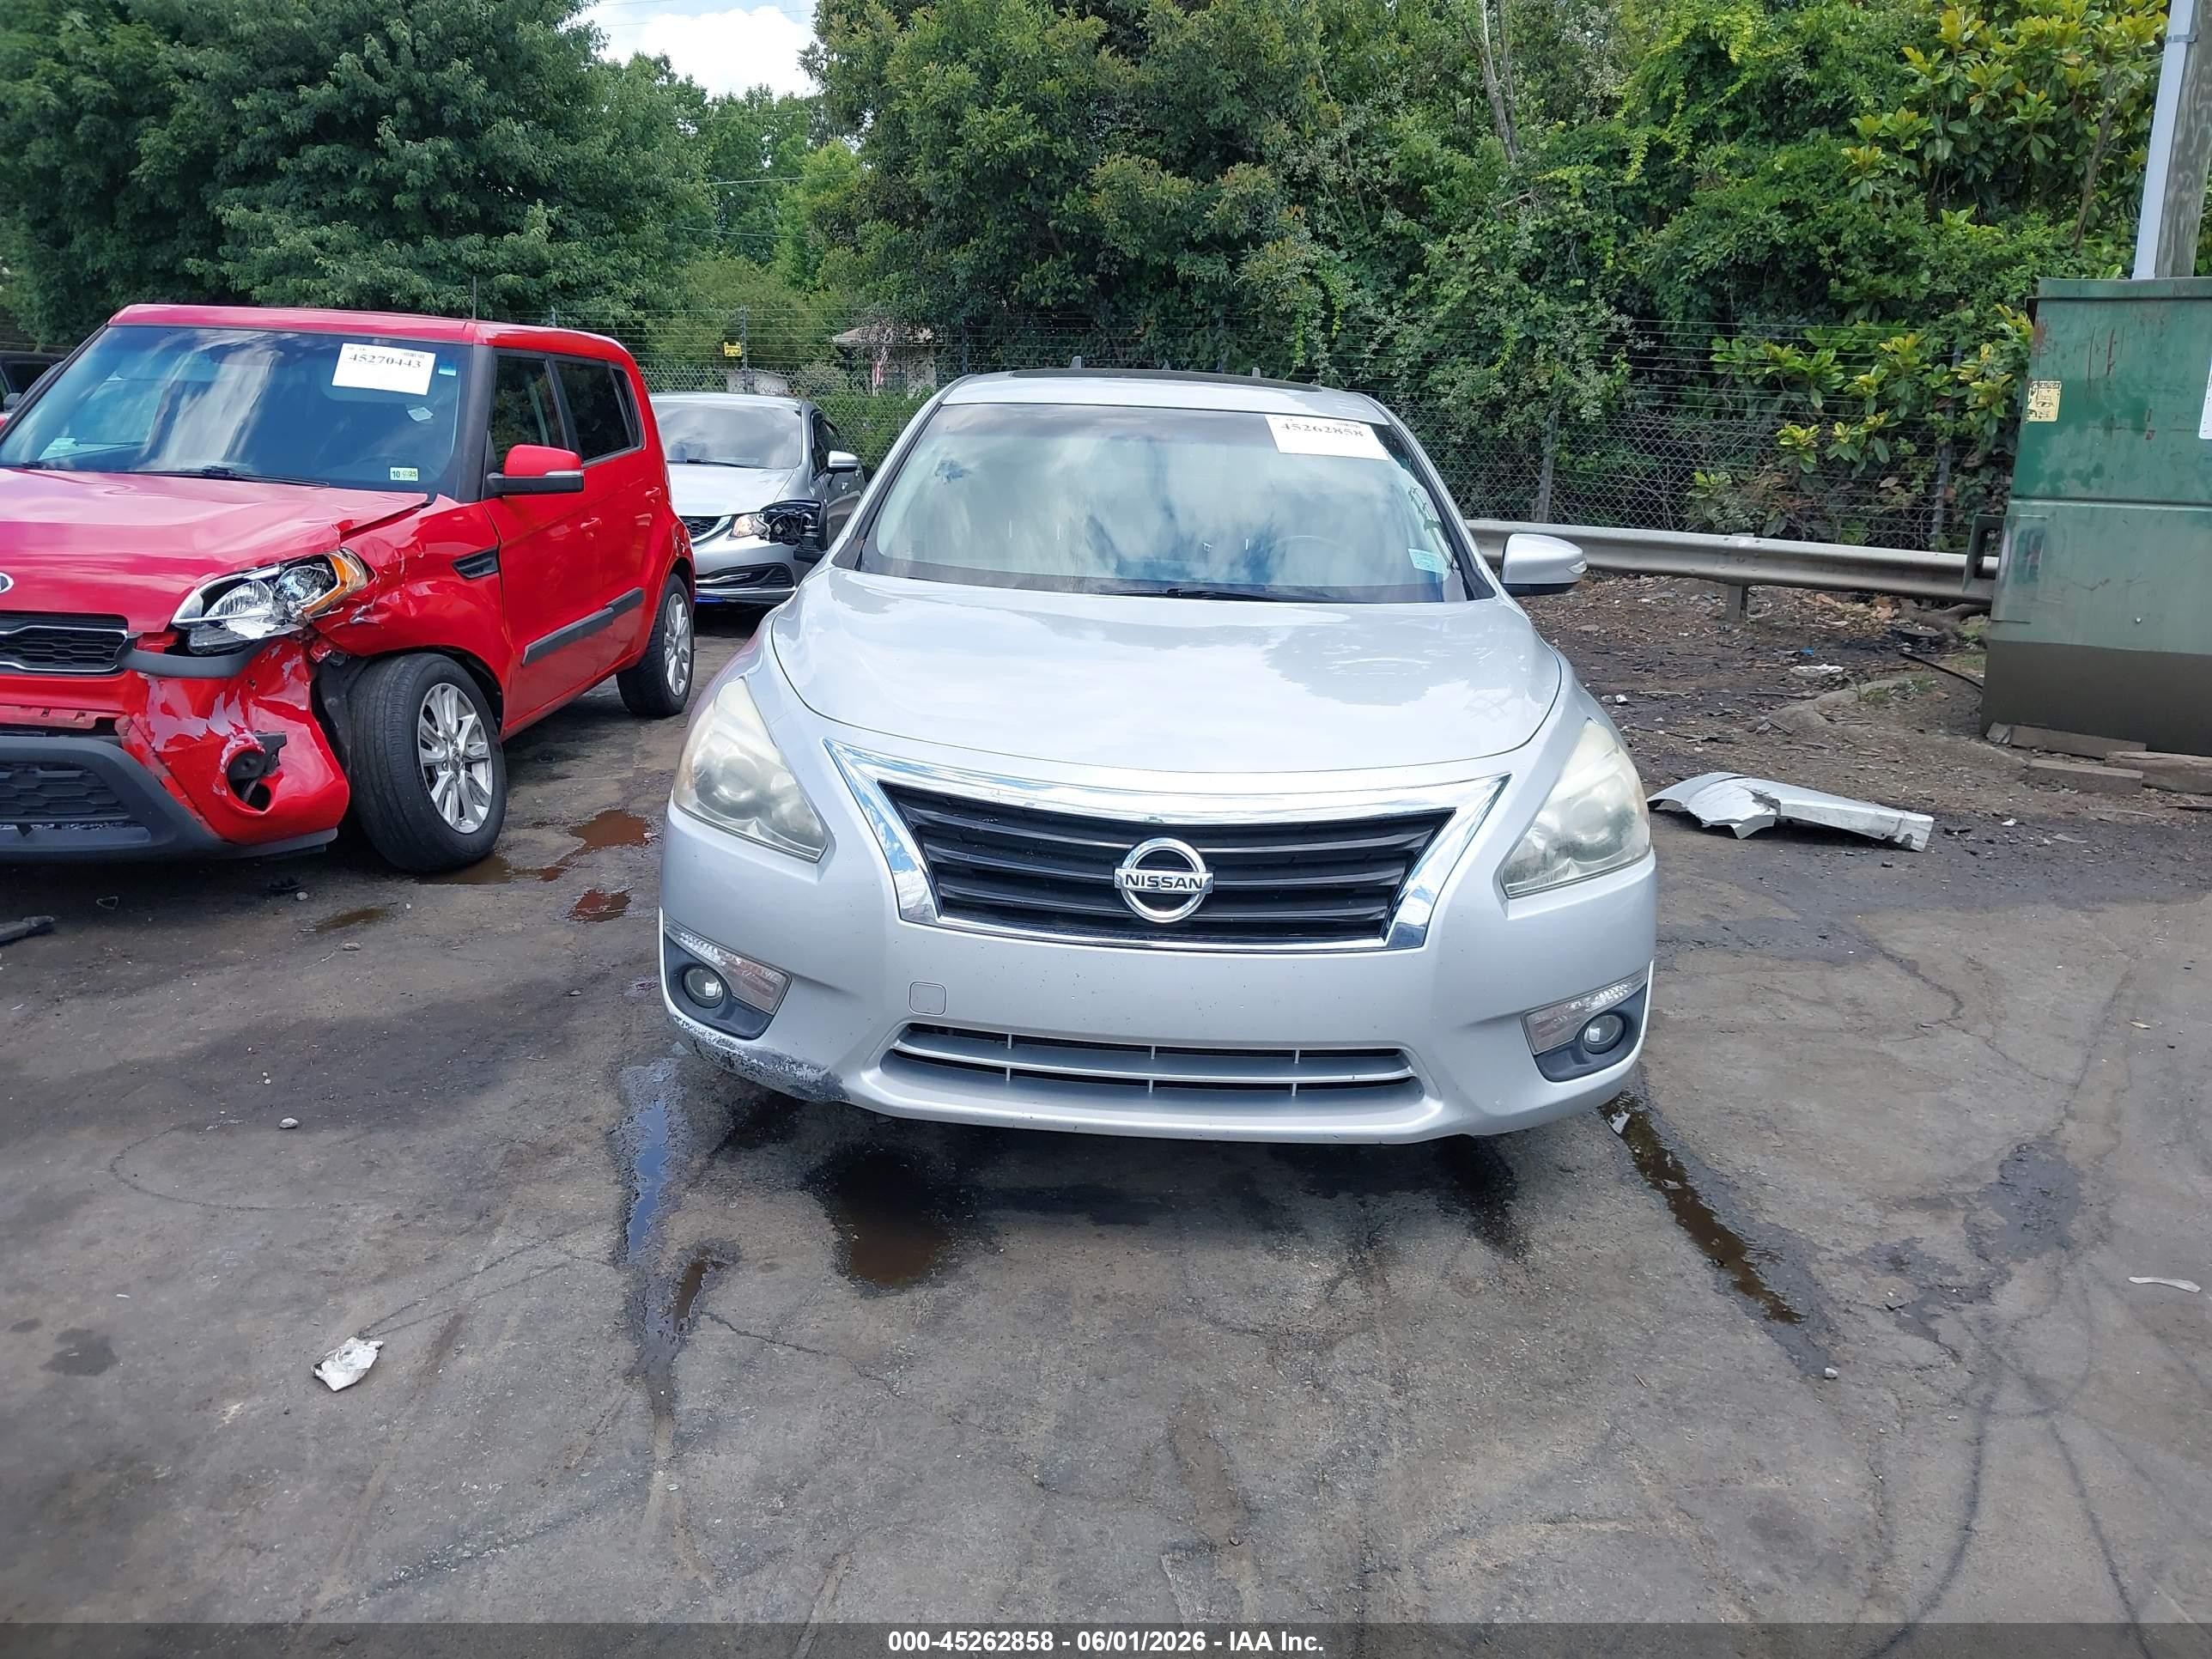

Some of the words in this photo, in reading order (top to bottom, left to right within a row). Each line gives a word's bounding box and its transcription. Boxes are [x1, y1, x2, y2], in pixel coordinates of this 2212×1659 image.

[349, 353, 422, 368] 45270443
[1280, 422, 1364, 437] 45262858
[1125, 873, 1203, 890] NISSAN
